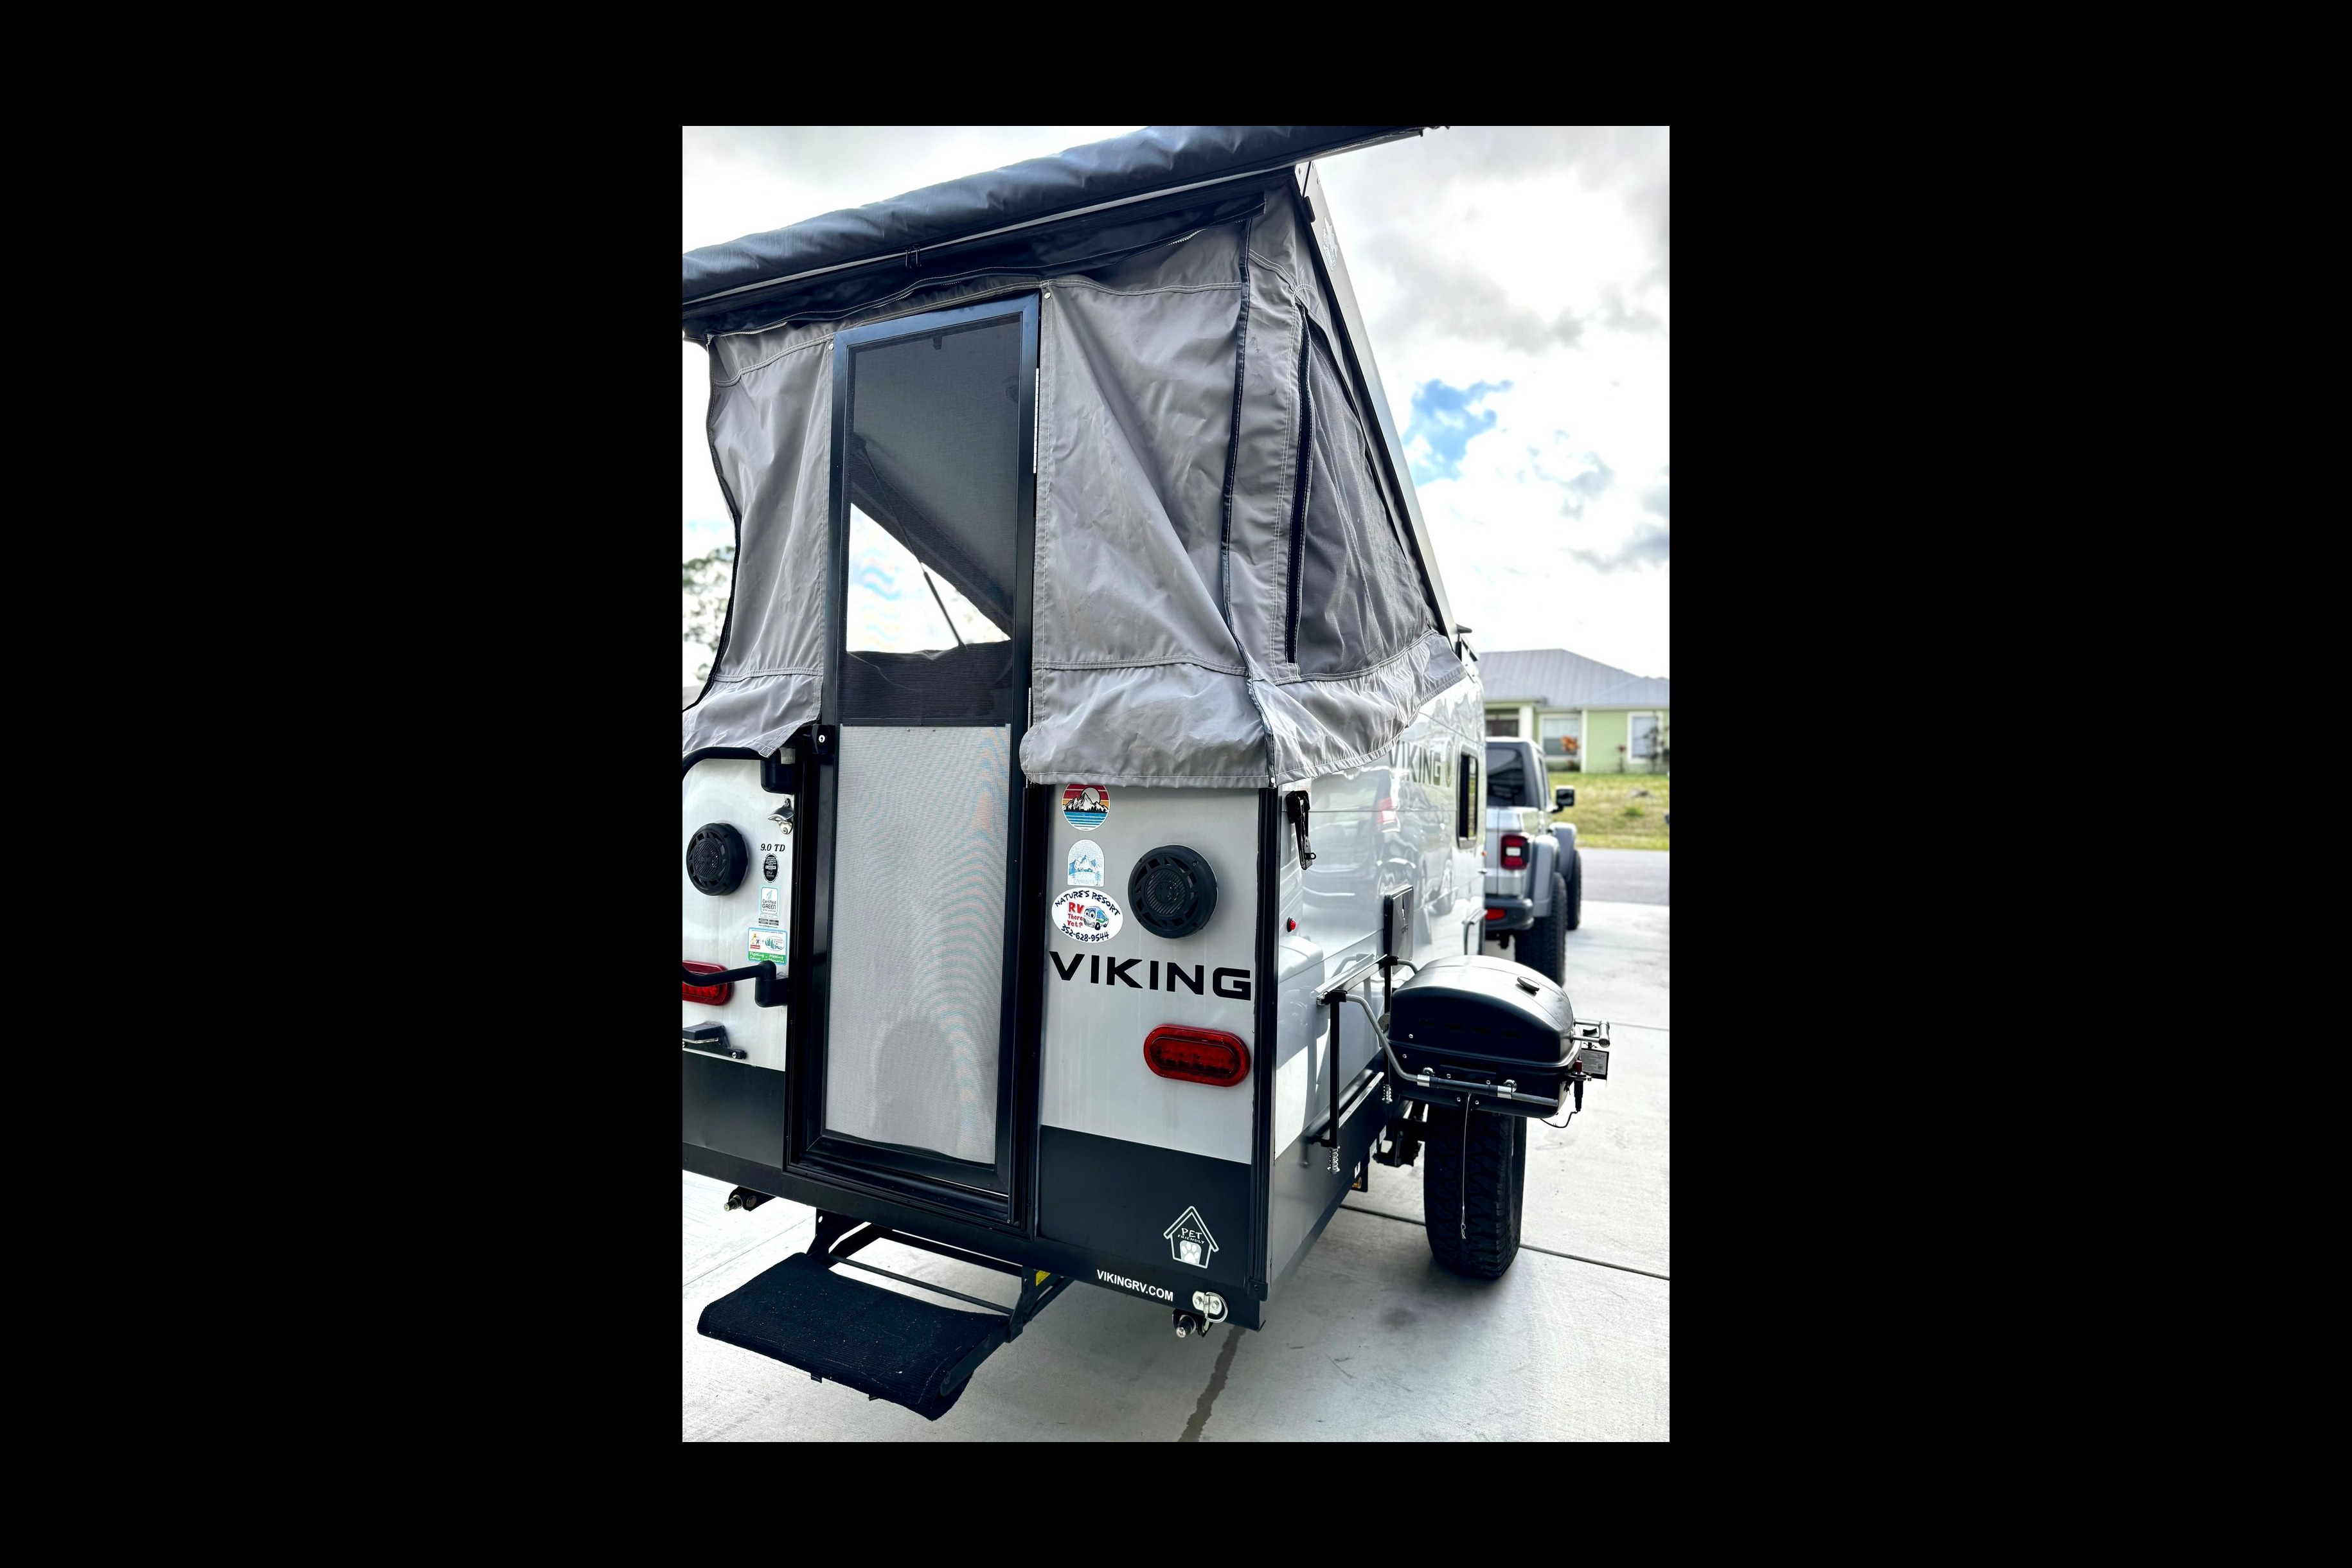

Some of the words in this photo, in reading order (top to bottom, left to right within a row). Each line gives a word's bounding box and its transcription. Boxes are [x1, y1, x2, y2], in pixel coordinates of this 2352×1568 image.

[1389, 740, 1441, 786] VIKING
[760, 843, 772, 851] 9.0
[1055, 890, 1090, 907] NATURE'S
[1092, 892, 1121, 916] RESORT
[1068, 902, 1085, 913] RV
[1061, 923, 1109, 942] 352-628-9544
[1049, 950, 1252, 1001] VIKING
[1177, 1234, 1205, 1244] FRIENDLY
[1181, 1227, 1202, 1240] PET
[1096, 1269, 1173, 1302] VIKINGRV.COM
